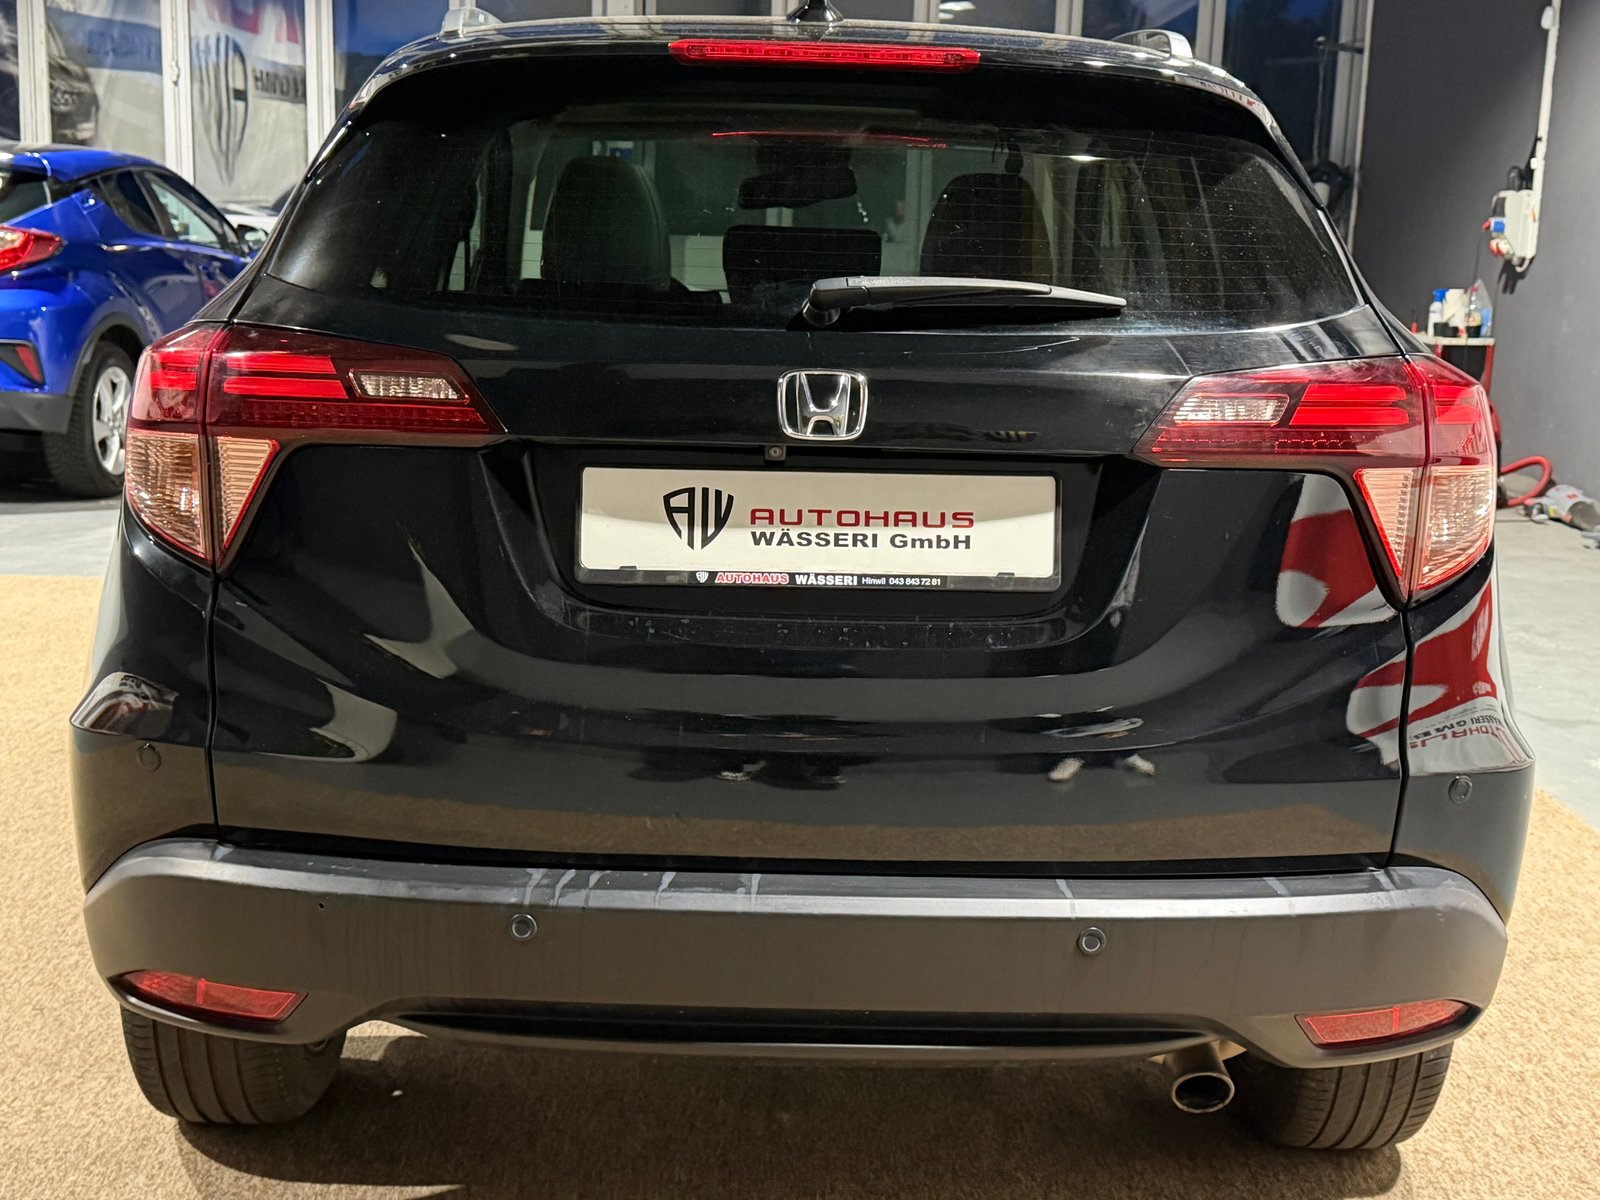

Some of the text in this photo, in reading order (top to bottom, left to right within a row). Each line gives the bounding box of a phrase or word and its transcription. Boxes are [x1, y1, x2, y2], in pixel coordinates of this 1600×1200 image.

[750, 508, 975, 529] AUTOHAUS
[750, 528, 971, 550] WÄSSERI GmbH
[715, 572, 790, 584] AUTOHAUS
[795, 573, 858, 586] WÄSSERI
[861, 576, 886, 585] Hinwil
[888, 577, 905, 586] 043
[905, 577, 920, 586] 843
[920, 577, 931, 586] 72
[931, 577, 941, 586] 81
